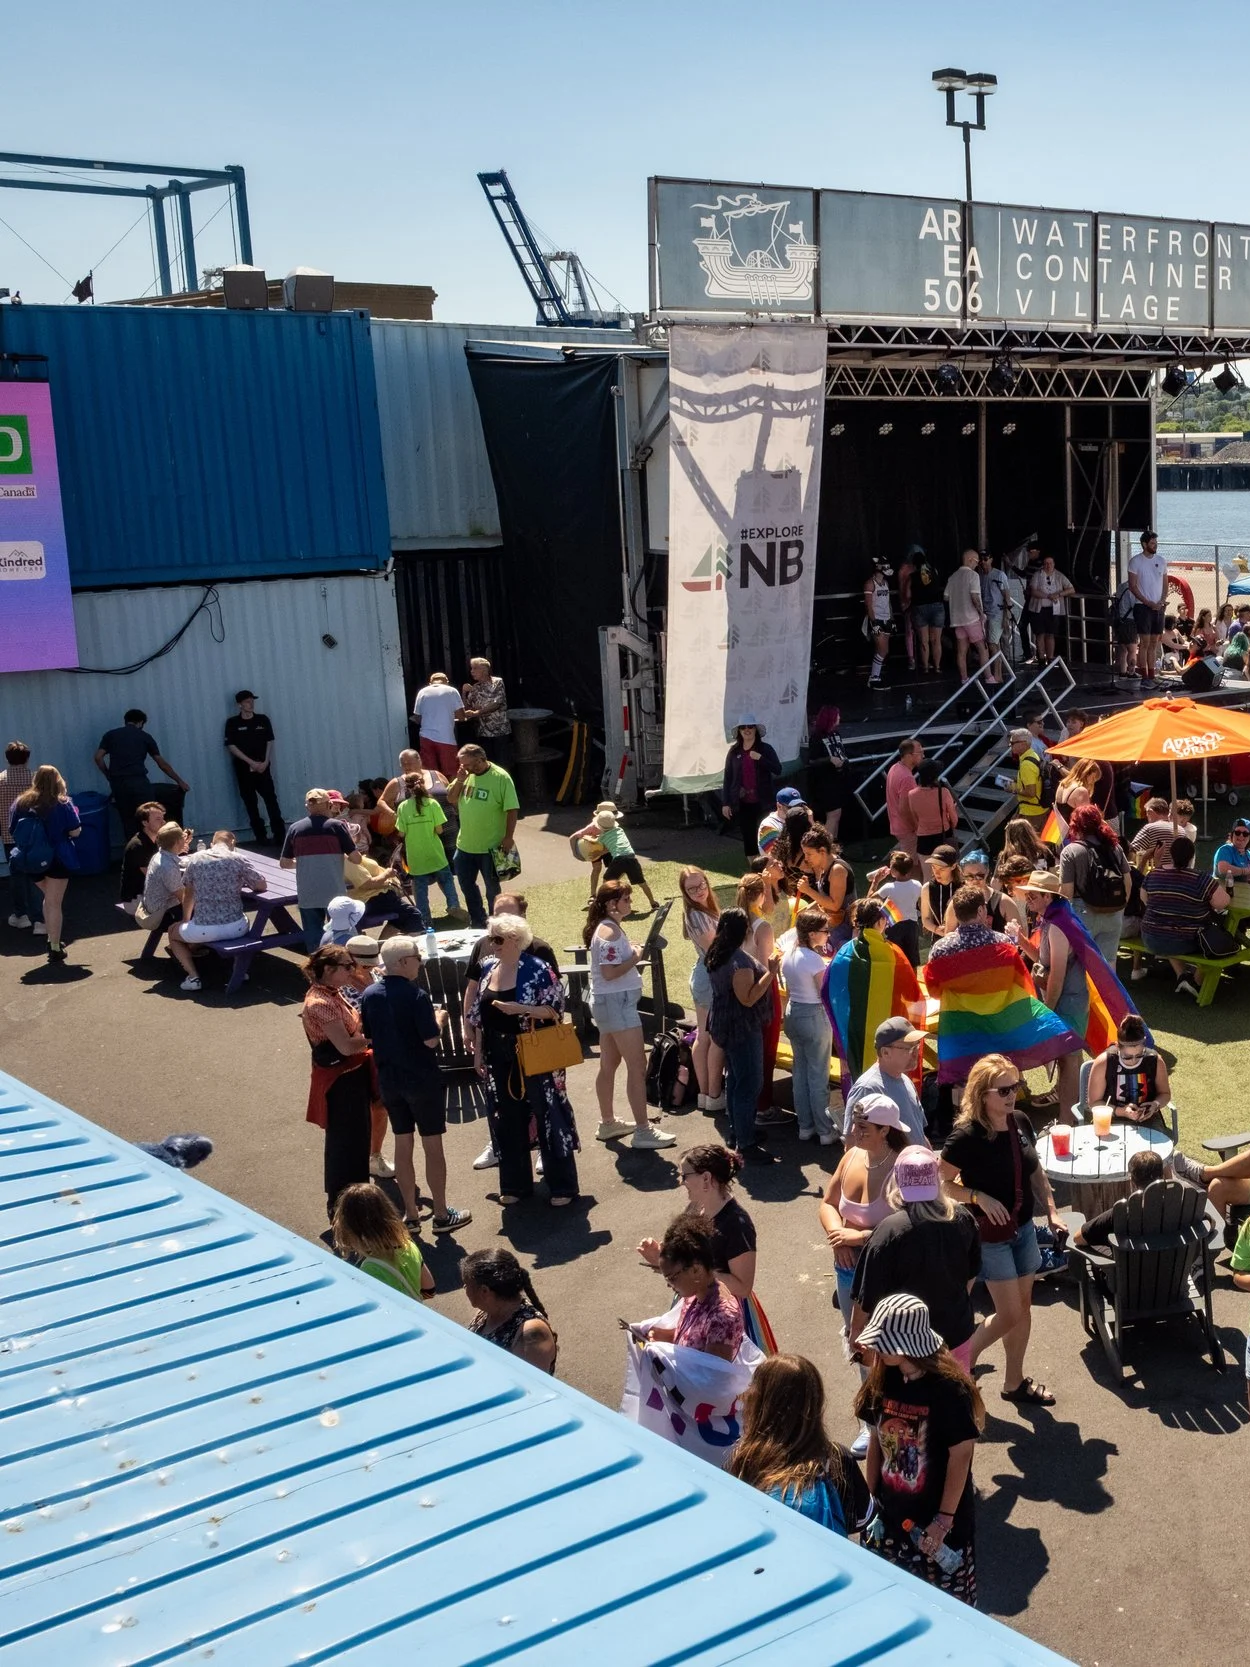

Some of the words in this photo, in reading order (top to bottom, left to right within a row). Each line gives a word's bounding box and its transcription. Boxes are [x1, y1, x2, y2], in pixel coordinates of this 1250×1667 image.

[919, 208, 961, 242] AR
[944, 245, 984, 279] EA
[1016, 253, 1231, 291] CONTAINER
[924, 279, 983, 312] 506
[1016, 289, 1180, 321] VILLAGE
[0, 426, 23, 462] D
[741, 525, 804, 540] #EXPLORE
[740, 540, 804, 588] NB
[1162, 731, 1225, 754] APEROL
[1176, 741, 1219, 758] SPRITZ
